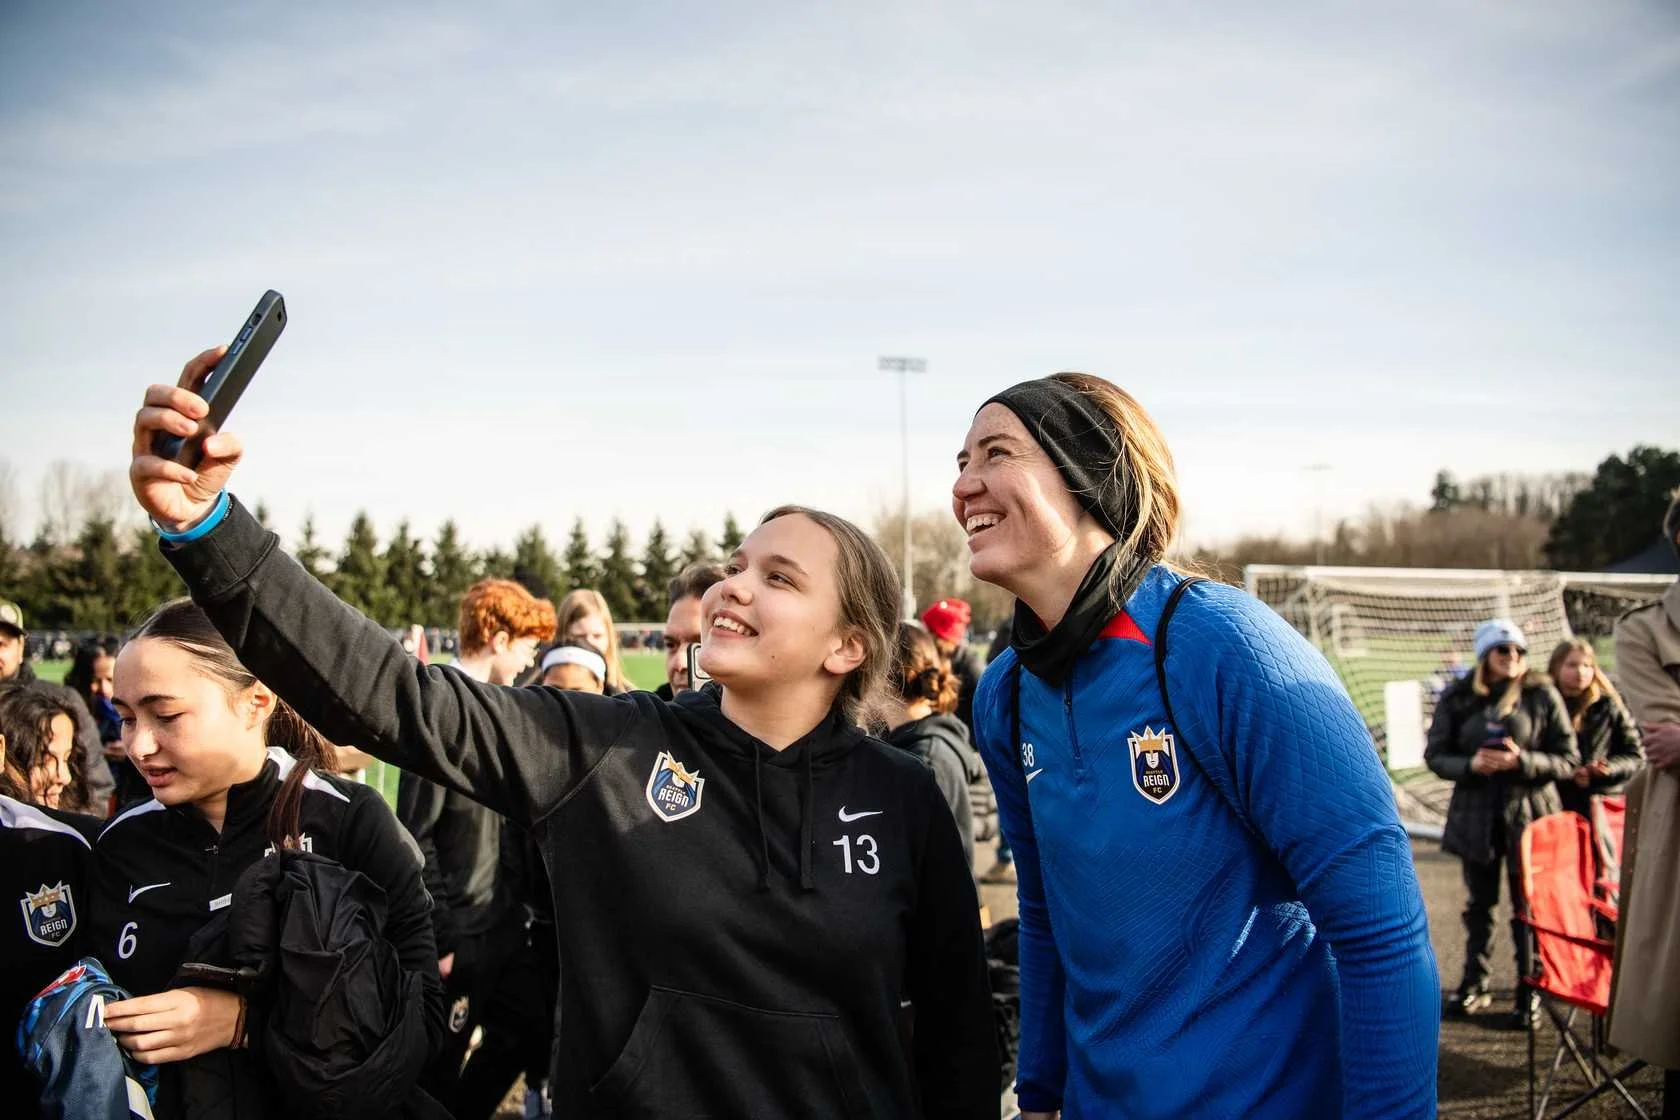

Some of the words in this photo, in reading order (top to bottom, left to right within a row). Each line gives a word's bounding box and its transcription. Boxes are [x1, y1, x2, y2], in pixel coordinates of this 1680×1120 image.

[1022, 742, 1035, 768] 38
[1143, 774, 1170, 787] REIGN
[658, 788, 689, 807] REIGN
[665, 803, 677, 811] FC
[832, 834, 880, 875] 13
[40, 919, 68, 936] REIGN
[118, 921, 138, 959] 6
